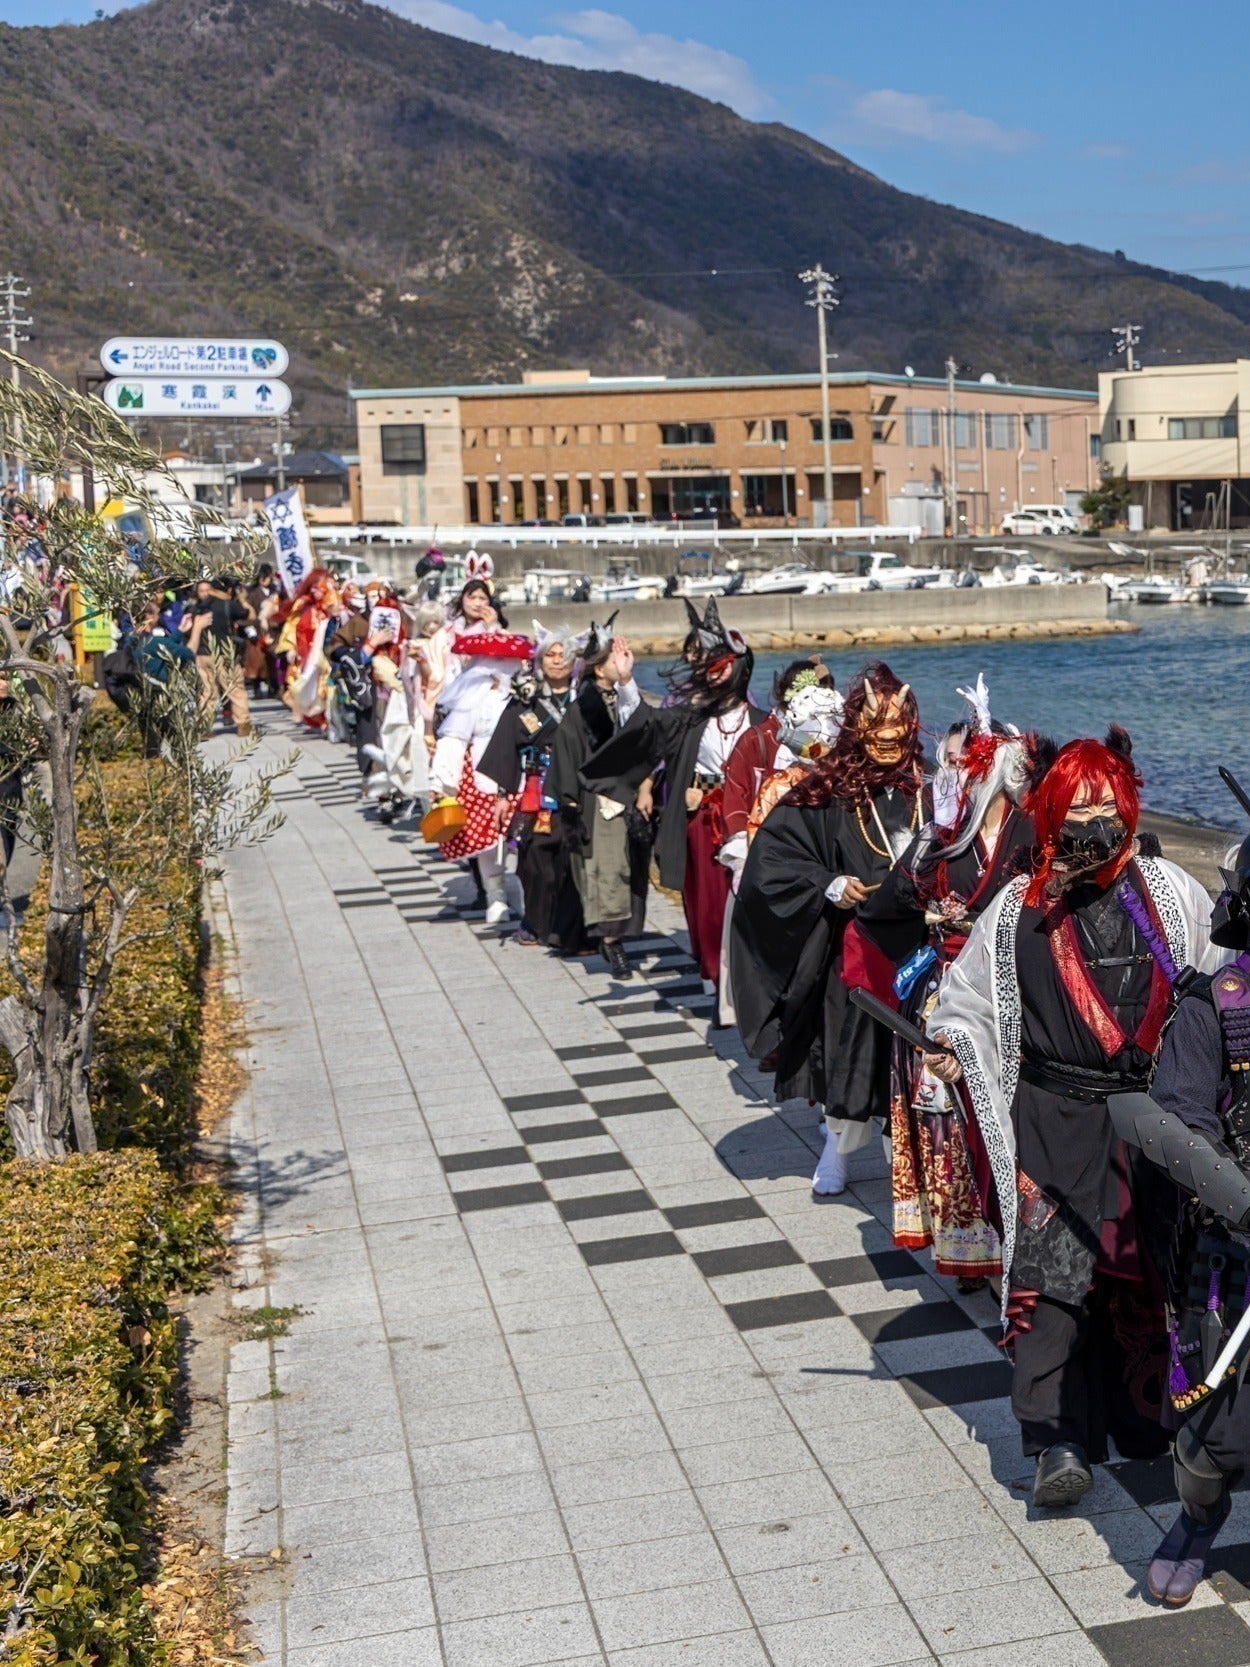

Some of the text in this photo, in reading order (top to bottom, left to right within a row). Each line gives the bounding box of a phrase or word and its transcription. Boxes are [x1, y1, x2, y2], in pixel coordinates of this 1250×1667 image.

[133, 362, 249, 373] Angel Road Second Parking
[181, 401, 220, 409] Kankakei
